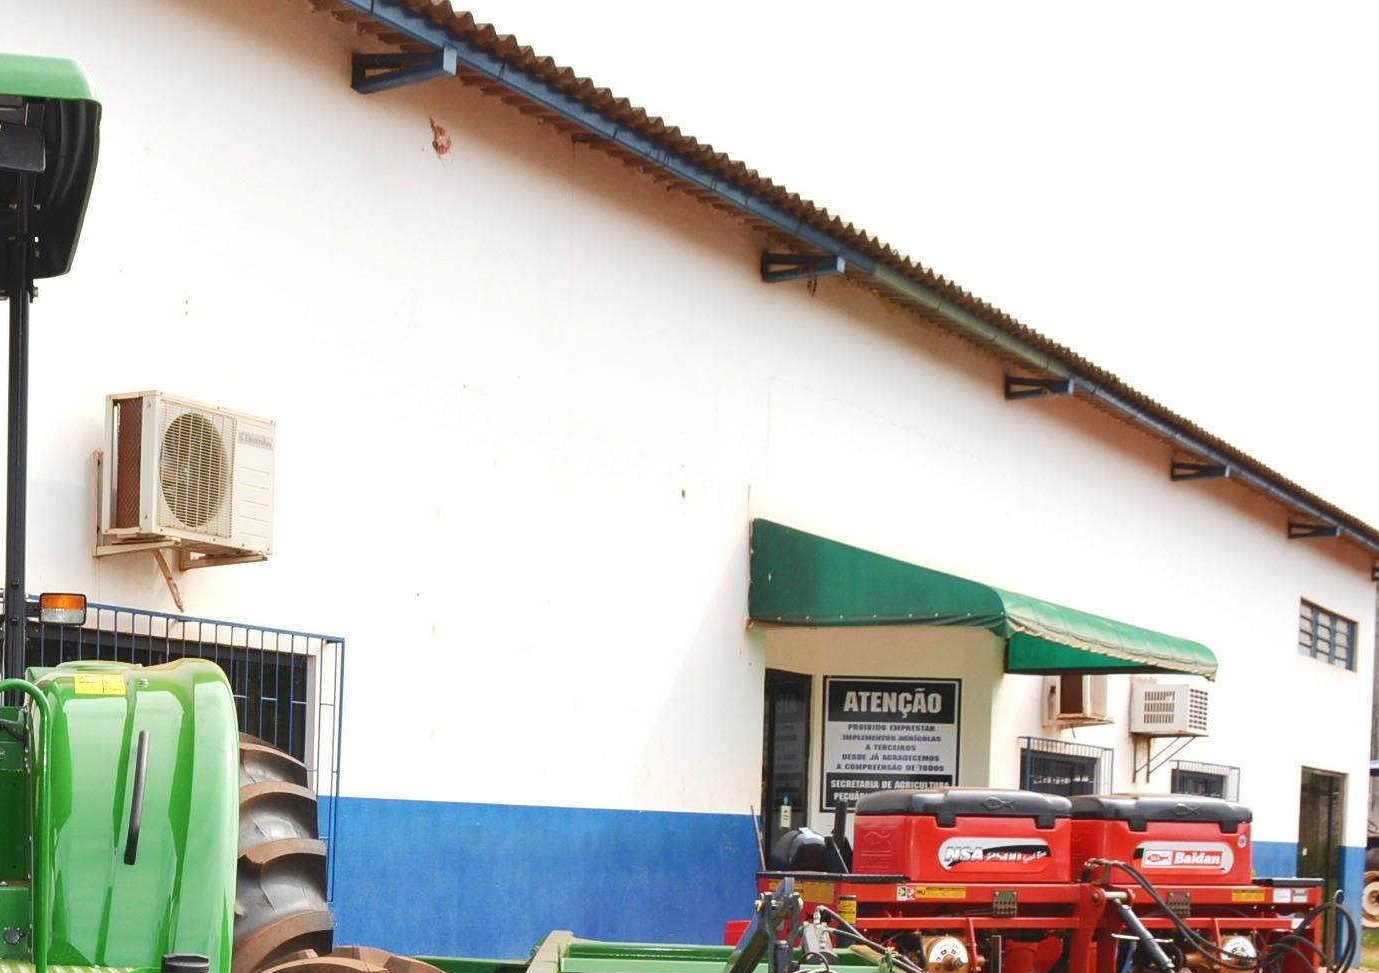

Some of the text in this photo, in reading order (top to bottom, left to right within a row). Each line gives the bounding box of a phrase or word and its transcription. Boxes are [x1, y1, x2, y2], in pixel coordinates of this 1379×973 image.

[843, 687, 942, 718] ATENÇÃO
[847, 723, 935, 732] PROIBIDO EMPRESTAR
[842, 734, 896, 742] IMPLEMENTOS
[841, 752, 940, 762] DESDE JÁ AGRADECEMOS
[844, 763, 903, 771] COMPREENSÃO
[830, 779, 880, 789] SECRETARIA
[881, 781, 892, 789] DE
[1174, 851, 1221, 865] Baldan
